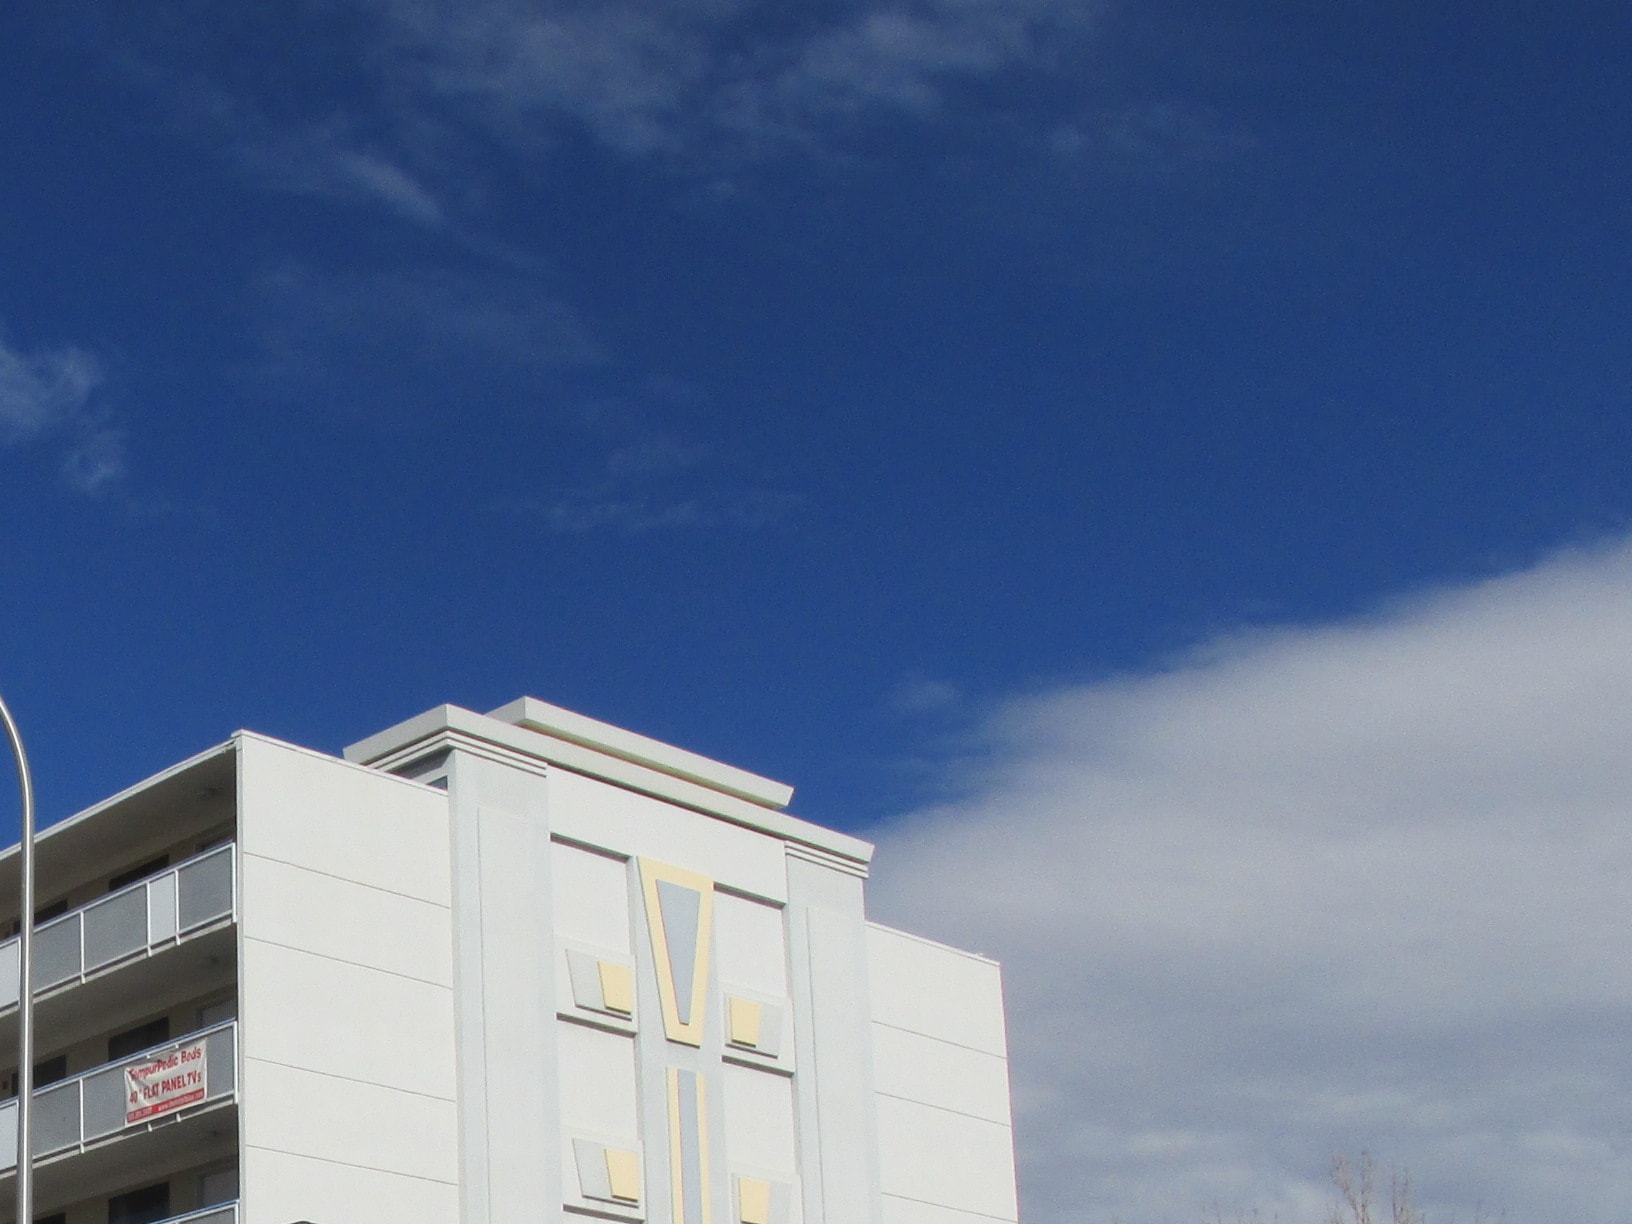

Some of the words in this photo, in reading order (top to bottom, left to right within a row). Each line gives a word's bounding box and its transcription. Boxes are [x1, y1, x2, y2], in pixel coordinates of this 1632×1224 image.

[181, 1047, 201, 1063] Beds
[143, 1083, 160, 1100] FLAT
[162, 1075, 187, 1094] PANEL
[187, 1070, 201, 1086] TVs
